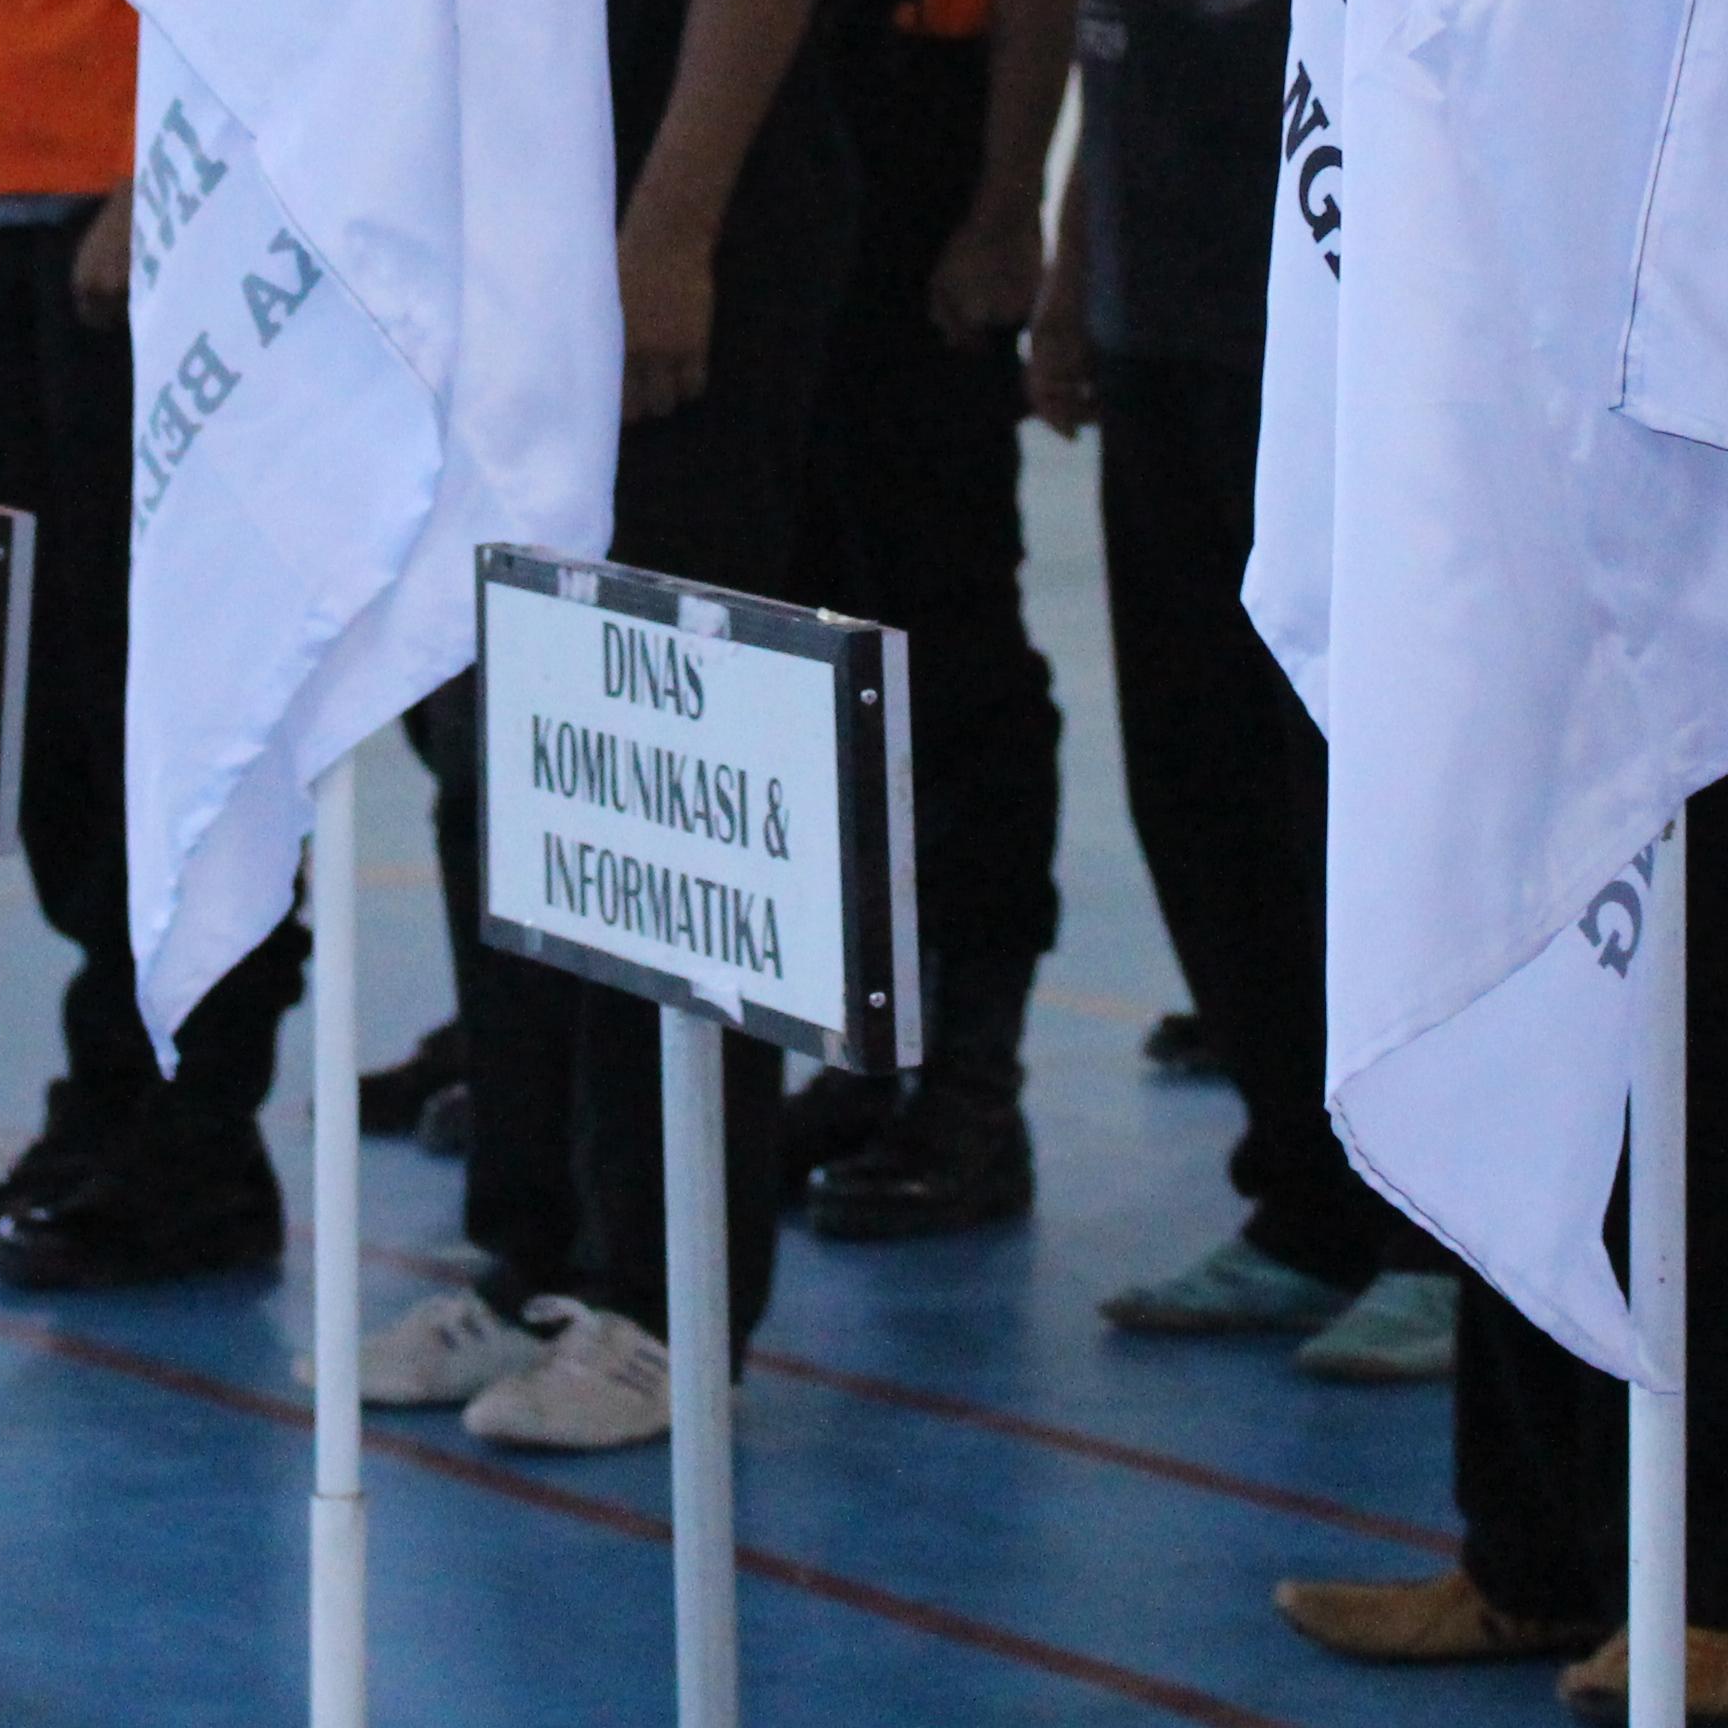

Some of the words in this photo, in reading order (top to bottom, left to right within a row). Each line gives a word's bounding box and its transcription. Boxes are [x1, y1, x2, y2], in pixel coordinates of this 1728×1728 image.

[601, 621, 706, 722] DINAS
[531, 714, 751, 849] KOMUNIKASI
[762, 776, 791, 862] &
[543, 830, 785, 980] INFORMATIKA
